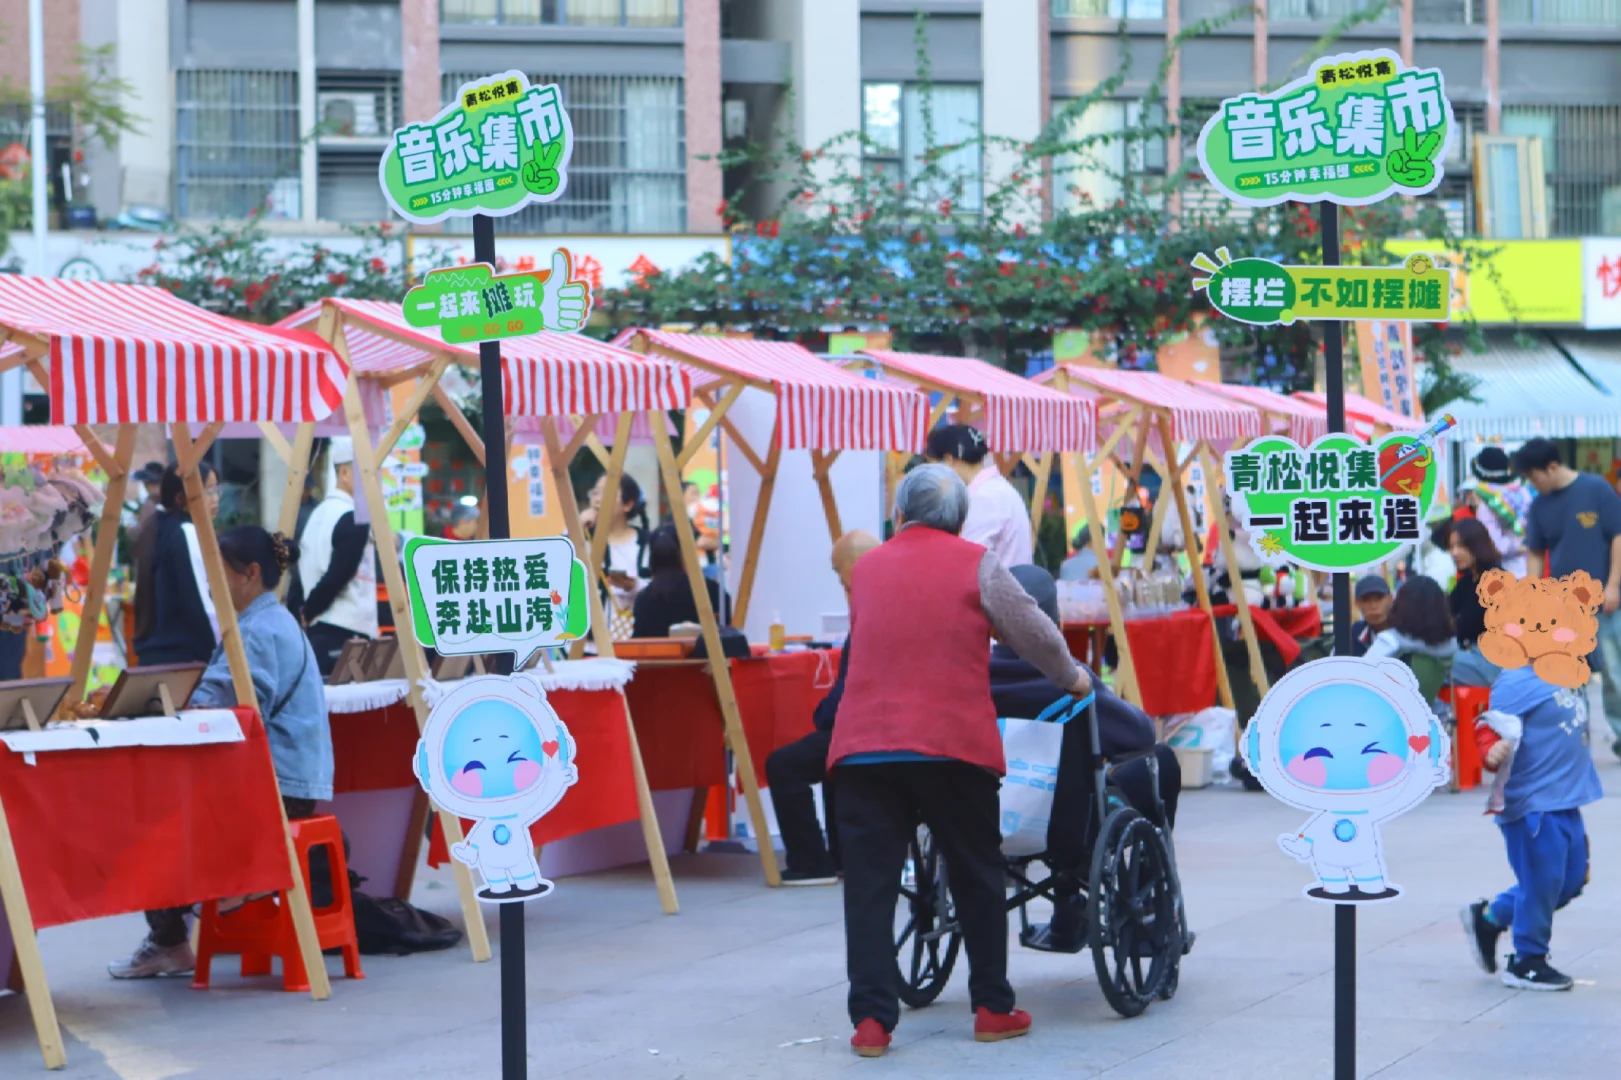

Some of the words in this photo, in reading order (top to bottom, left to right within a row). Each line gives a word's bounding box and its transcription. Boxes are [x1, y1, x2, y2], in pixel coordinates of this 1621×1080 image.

[1320, 61, 1390, 84] 青松悦集
[465, 81, 519, 107] 青松悦集
[397, 89, 563, 185] 音乐集市
[1226, 74, 1442, 161] 音乐集市
[416, 281, 536, 319] 一起来摊玩
[460, 326, 477, 338] GO
[484, 323, 500, 335] GO
[507, 320, 524, 333] GO
[1230, 450, 1378, 492] 青松悦集
[1250, 498, 1419, 541] 一起来造
[432, 552, 549, 595] 保持热爱
[436, 597, 553, 635] 奔赴山海
